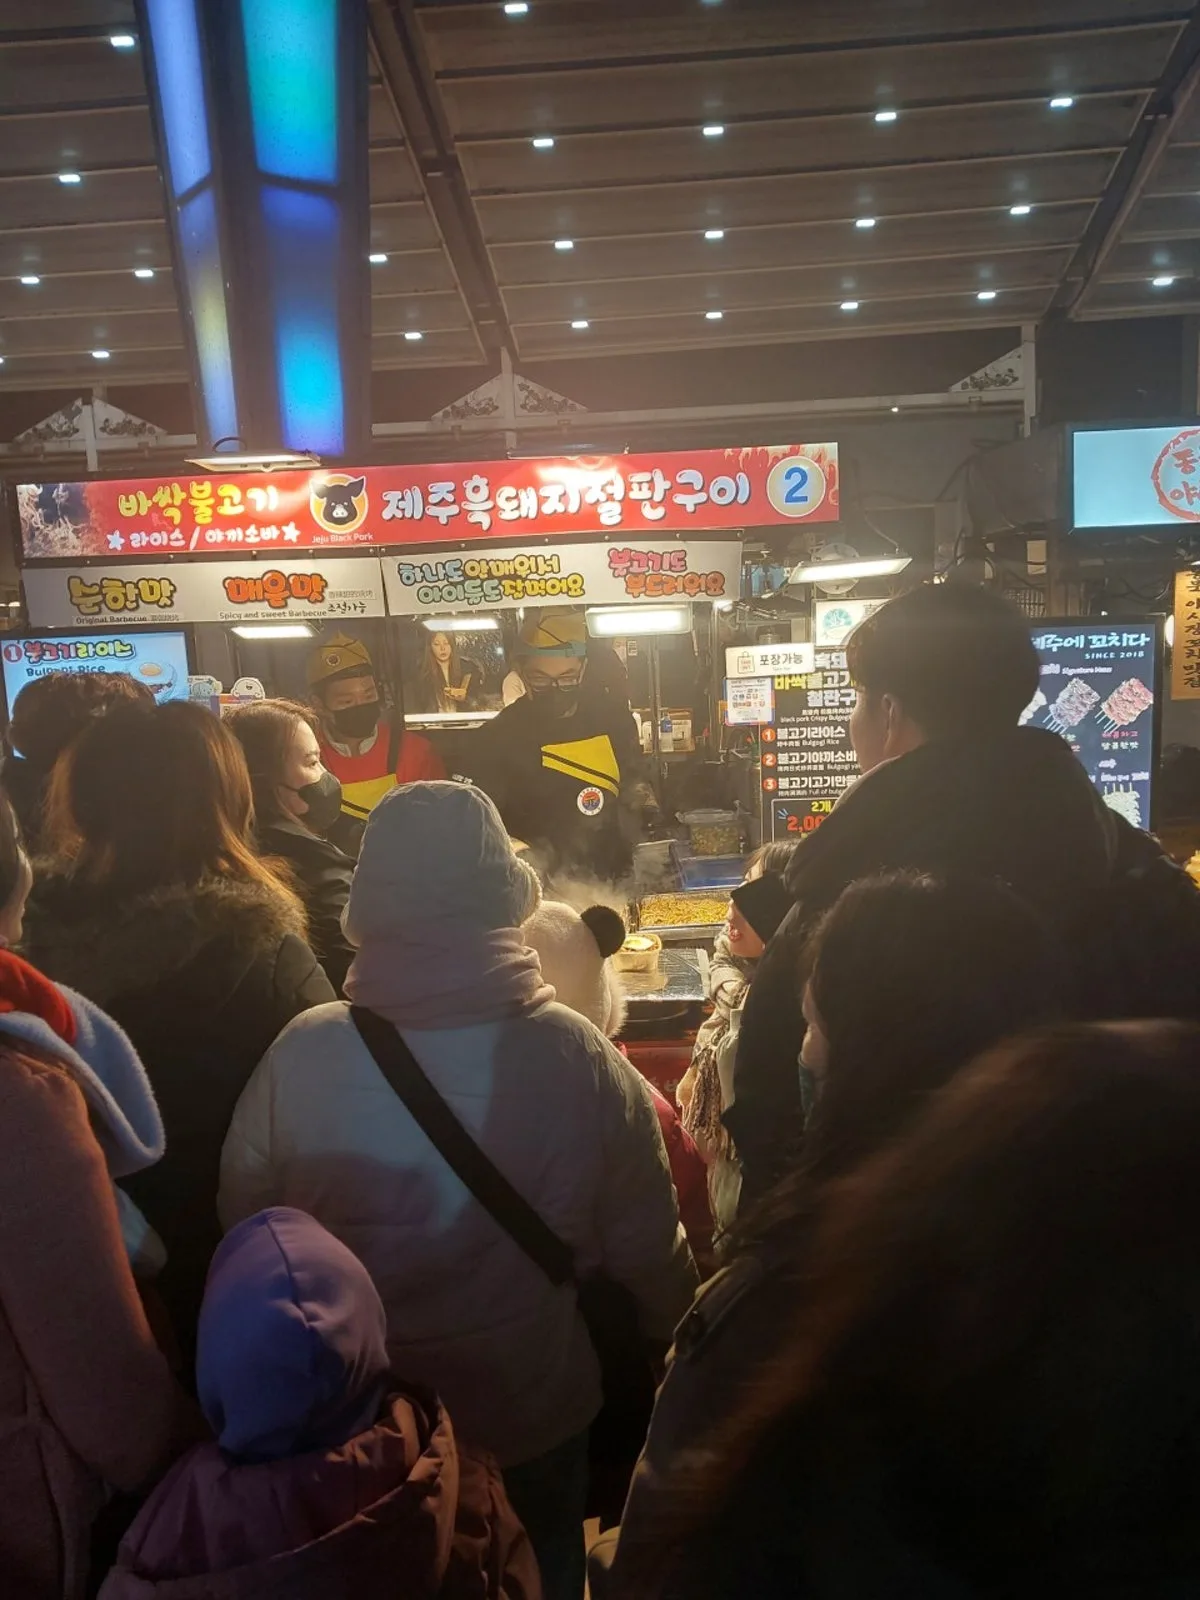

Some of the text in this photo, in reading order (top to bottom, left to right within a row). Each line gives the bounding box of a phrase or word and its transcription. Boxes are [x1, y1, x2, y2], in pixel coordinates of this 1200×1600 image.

[783, 466, 809, 504] 2
[118, 480, 281, 525] 바싹불고기
[129, 528, 186, 548] 라이스
[204, 524, 281, 544] 야끼소바
[311, 532, 374, 545] Jeju Black Pork
[397, 558, 464, 586] 하나도
[607, 547, 688, 577] 불고기도
[67, 575, 177, 616] 순한맛
[222, 569, 328, 609] 매운맛
[623, 571, 725, 598] 부드러워요
[75, 615, 108, 625] Original
[109, 614, 148, 624] Barbecue
[219, 612, 242, 621] Spicy
[244, 611, 259, 619] and
[288, 609, 328, 618] Barbecue
[23, 639, 136, 665] 불고기라이스
[1088, 631, 1151, 649] 꼬치다
[759, 652, 804, 667] 포장가능
[1084, 652, 1116, 660] SINCE
[777, 726, 846, 740] 불고기라이스
